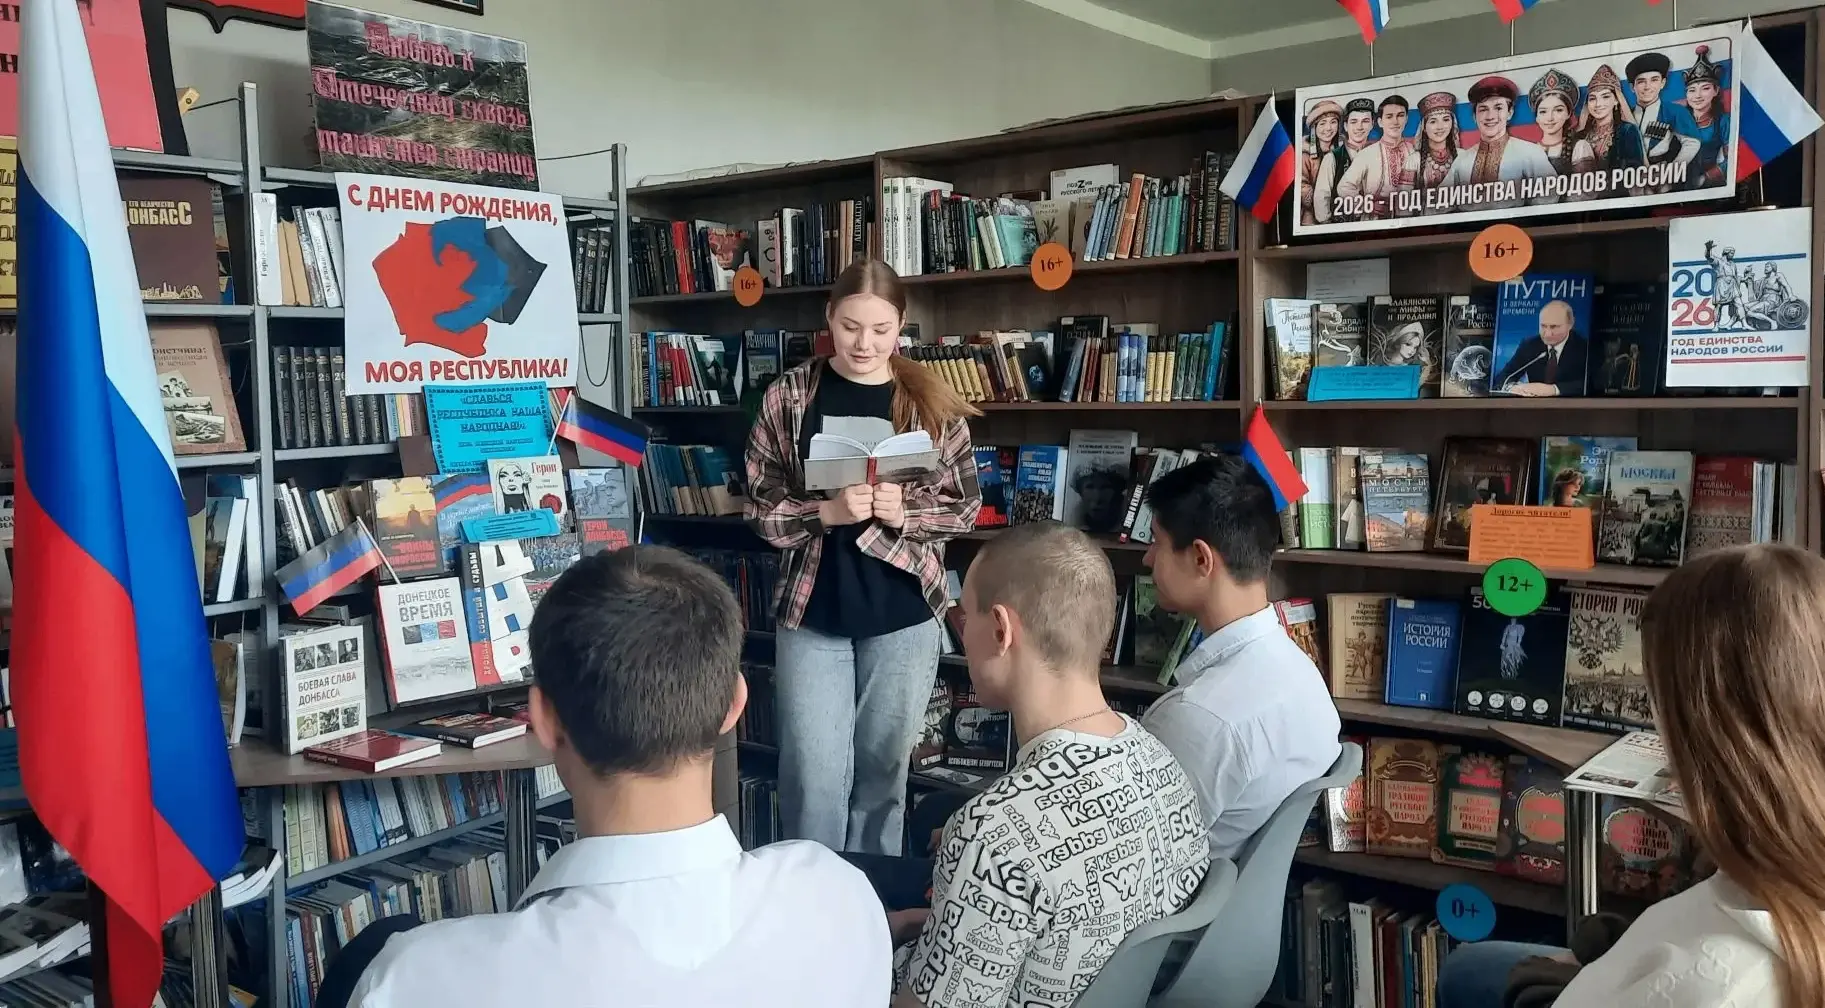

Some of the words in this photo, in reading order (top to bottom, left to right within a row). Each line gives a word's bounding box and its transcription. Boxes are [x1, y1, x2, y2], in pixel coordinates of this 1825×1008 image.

[1333, 194, 1374, 216] 2026
[1389, 190, 1422, 213] ГОД
[1426, 180, 1517, 209] ЕДИНСТВА
[1520, 169, 1607, 199] НАРОДОВ
[1611, 160, 1688, 191] РОССИИ
[121, 200, 192, 227] ОНБАСС
[348, 183, 363, 206] С
[367, 186, 435, 213] ДНЕМ
[440, 192, 559, 226] РОЖДЕНИЯ,
[1483, 242, 1520, 259] 16+
[1040, 258, 1064, 273] 16+
[740, 281, 757, 290] 16+
[1503, 279, 1586, 300] ПУТИН
[1671, 268, 1717, 298] 20
[1671, 297, 1716, 327] 26
[1671, 338, 1694, 347] ГОД
[1699, 336, 1763, 346] ЕДИНСТВА
[1671, 347, 1728, 356] НАРОДОВ
[1732, 345, 1783, 353] РОССИИ
[365, 361, 424, 383] МОЯ
[429, 357, 568, 381] РЕСПУБЛИКА!
[1497, 574, 1534, 593] 12+
[397, 588, 450, 605] ДОНЕЦКОЕ
[1571, 592, 1618, 614] СТОРИЯ
[399, 601, 453, 622] ВРЕМЯ
[1403, 622, 1451, 638] ИСТОРИЯ
[1405, 634, 1448, 649] РОССИИ
[298, 678, 330, 693] БОЕВАЯ
[331, 671, 357, 687] СЛАВА
[298, 689, 341, 707] ДОНБАССА
[1060, 784, 1138, 828] Kappa
[1107, 805, 1154, 839] Kappa
[1451, 897, 1481, 919] 0+
[1082, 923, 1121, 938] Kappa
[1024, 980, 1081, 1003] Kapp
